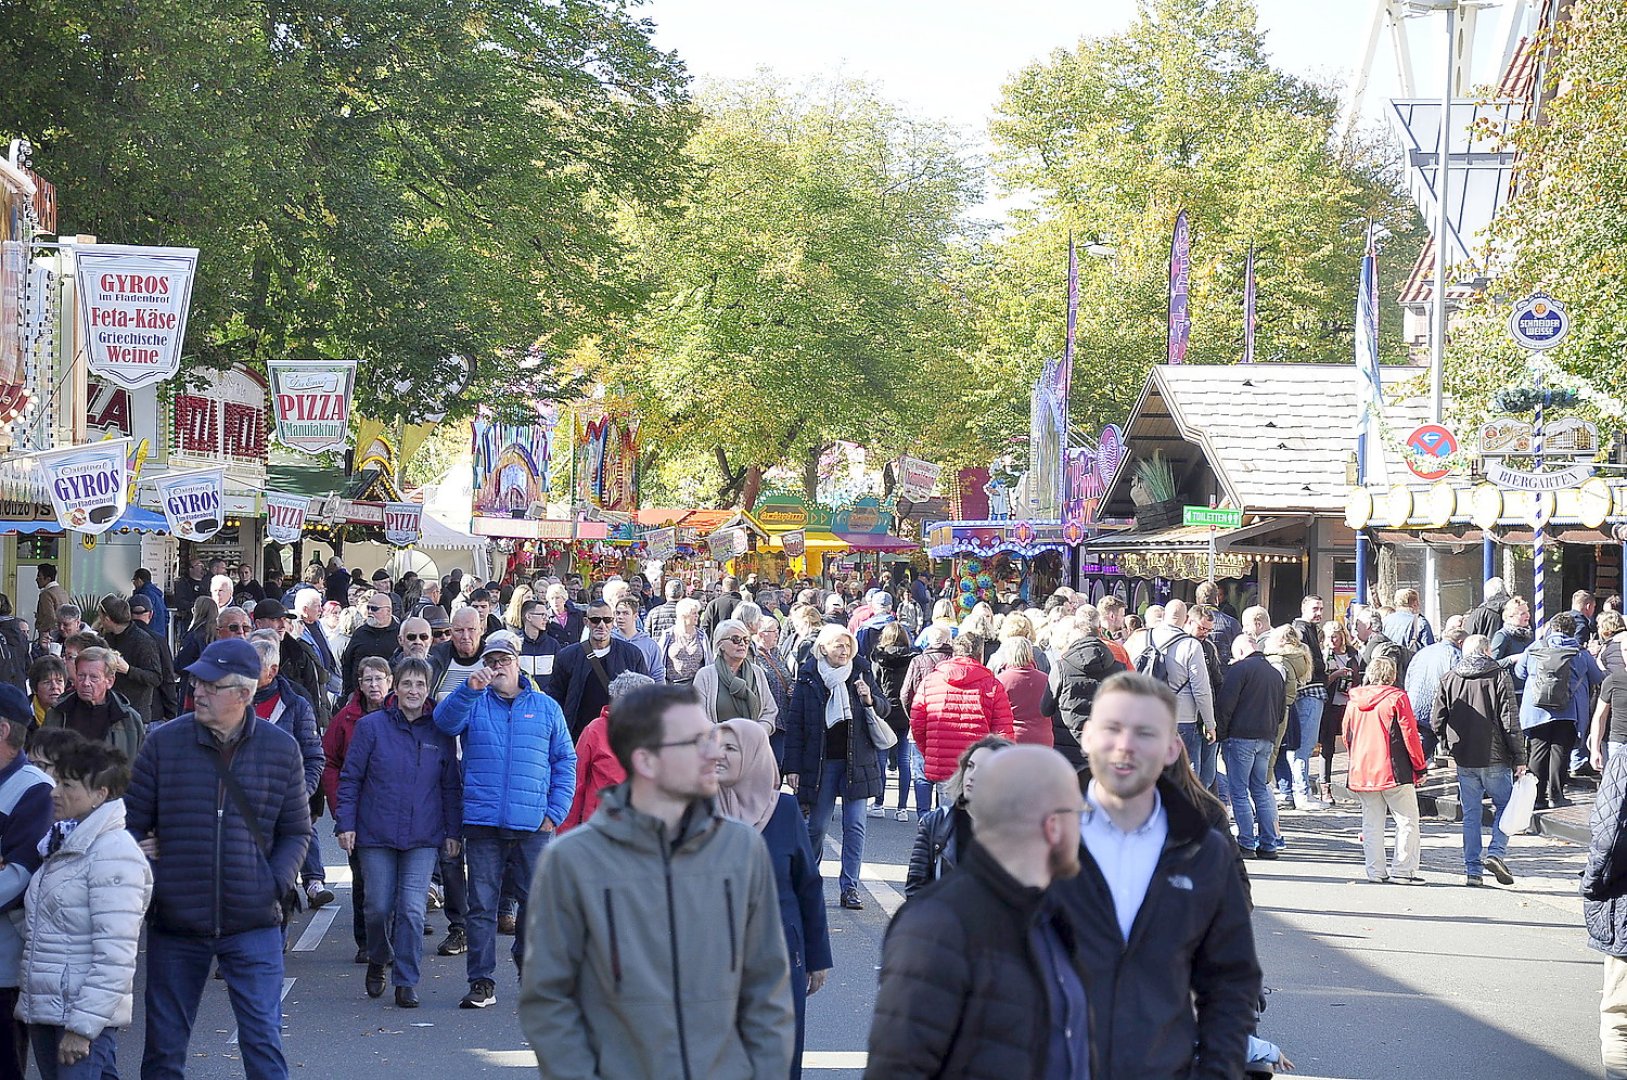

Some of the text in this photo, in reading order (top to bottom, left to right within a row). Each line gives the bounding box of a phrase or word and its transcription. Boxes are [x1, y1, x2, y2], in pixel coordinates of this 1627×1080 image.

[100, 273, 169, 294] GYROS
[115, 293, 170, 304] Fladenbrot
[91, 307, 176, 330] Feta-Käse
[1519, 319, 1560, 328] SCHNEIDER
[98, 331, 168, 346] Griechische
[1525, 327, 1554, 336] WEISSE
[106, 345, 159, 364] Weine
[277, 394, 345, 421] PIZZA
[285, 422, 339, 437] Manufaktur
[54, 469, 120, 501] GYROS
[1499, 471, 1579, 489] BIERGARTEN
[167, 490, 219, 516] GYROS
[267, 503, 305, 529] PIZZA
[385, 512, 419, 532] PIZZA
[1192, 511, 1228, 523] TOILETTEN
